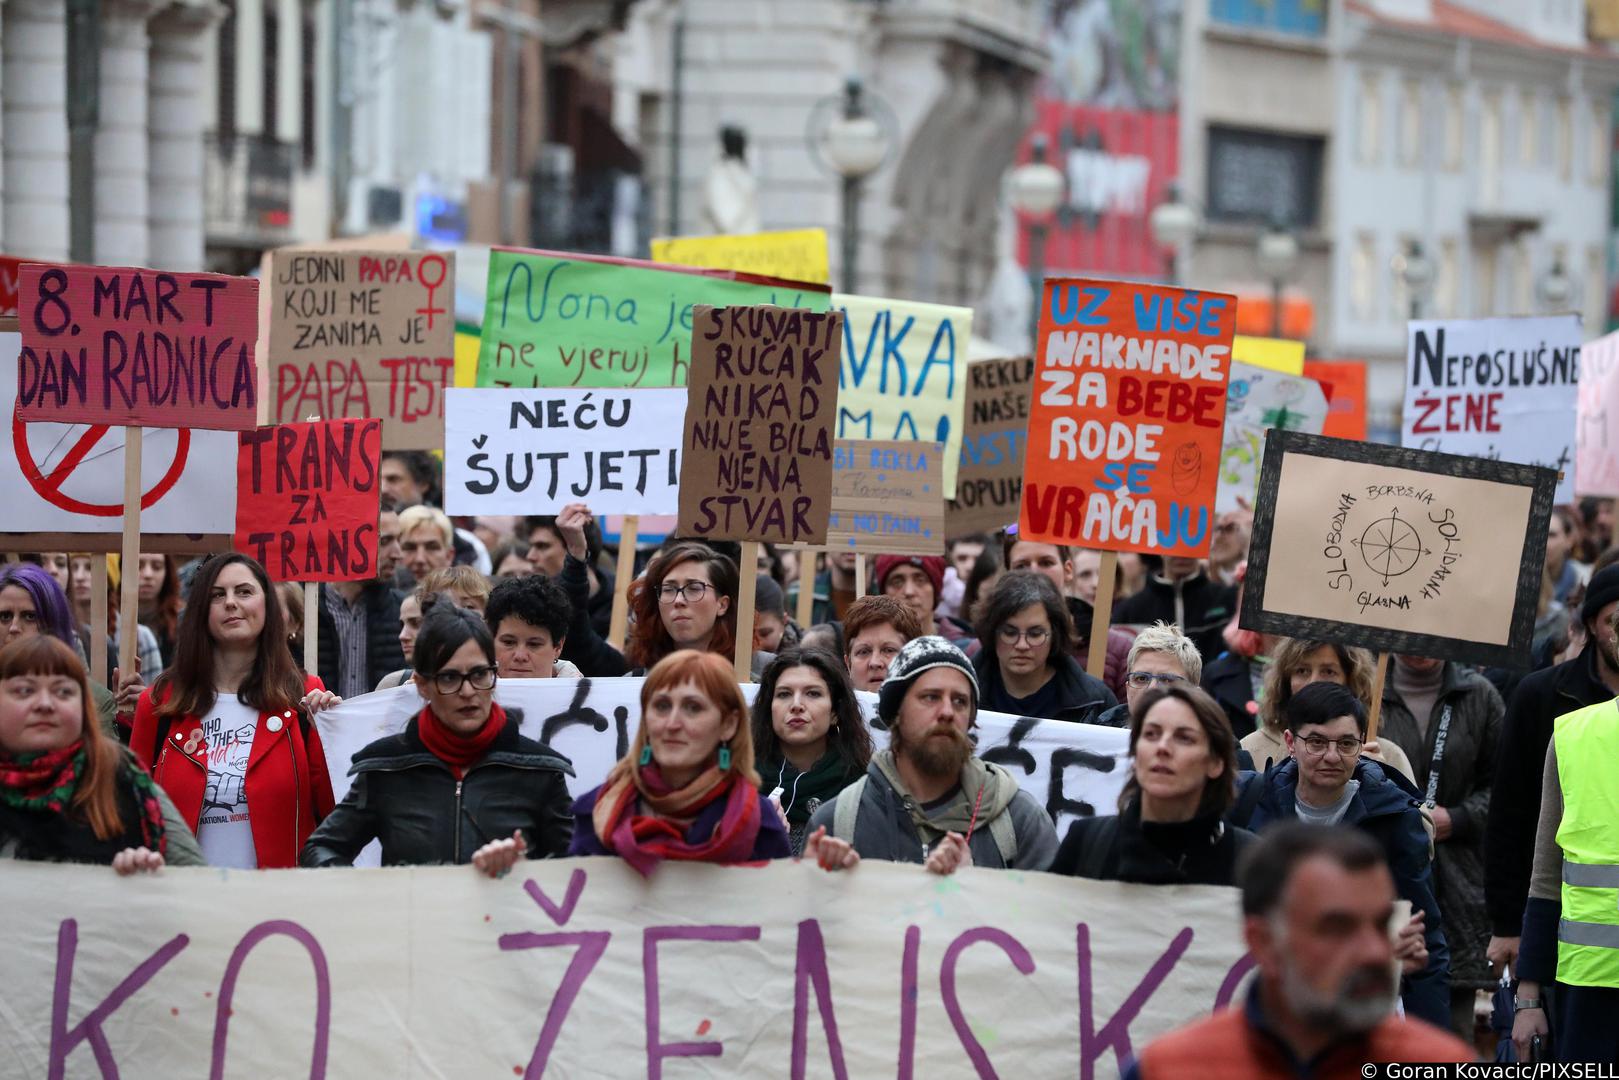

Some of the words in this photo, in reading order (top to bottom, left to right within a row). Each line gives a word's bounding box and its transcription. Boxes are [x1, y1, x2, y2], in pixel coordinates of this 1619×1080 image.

[279, 256, 345, 284] JEDINI
[358, 258, 414, 283] PAPA
[34, 268, 81, 336] 8.
[92, 272, 228, 328] MART
[284, 290, 341, 319] KOJI
[349, 289, 381, 315] ME
[501, 261, 640, 330] Nona
[1049, 285, 1112, 326] UZ
[1132, 290, 1228, 337] VIŠE
[293, 322, 383, 350] ZANIMA
[399, 317, 425, 346] JE
[704, 305, 842, 352] SKUVATI
[19, 346, 88, 409] DAN
[103, 329, 256, 410] RADNICA
[497, 341, 536, 369] ne
[558, 341, 650, 387] vjeruj
[714, 339, 824, 386] RUČAK
[838, 306, 956, 399] VKA
[1045, 330, 1230, 382] NAKNADE
[276, 362, 371, 421] PAPA
[379, 357, 454, 422] TEST
[509, 392, 631, 430] NEĆU
[705, 382, 821, 422] NIKAD
[973, 391, 1028, 425] NAŠE
[1040, 370, 1108, 408] ZA
[1117, 375, 1226, 428] BEBE
[1412, 390, 1504, 435] ŽENE
[240, 421, 378, 495] TRANS
[691, 419, 752, 452] NIJE
[769, 421, 833, 461] BILA
[1049, 416, 1165, 462] RODE
[464, 434, 678, 500] ŠUTJETI
[717, 453, 803, 495] NJENA
[1093, 463, 1157, 494] SE
[289, 494, 327, 525] ZA
[693, 496, 815, 537] STVAR
[1025, 481, 1210, 550] VRAČAJU
[248, 523, 375, 579] TRANS
[1323, 492, 1358, 593] SLOBODNA
[1439, 703, 1453, 731] RIGHT
[497, 868, 1257, 1080] ŽENSK
